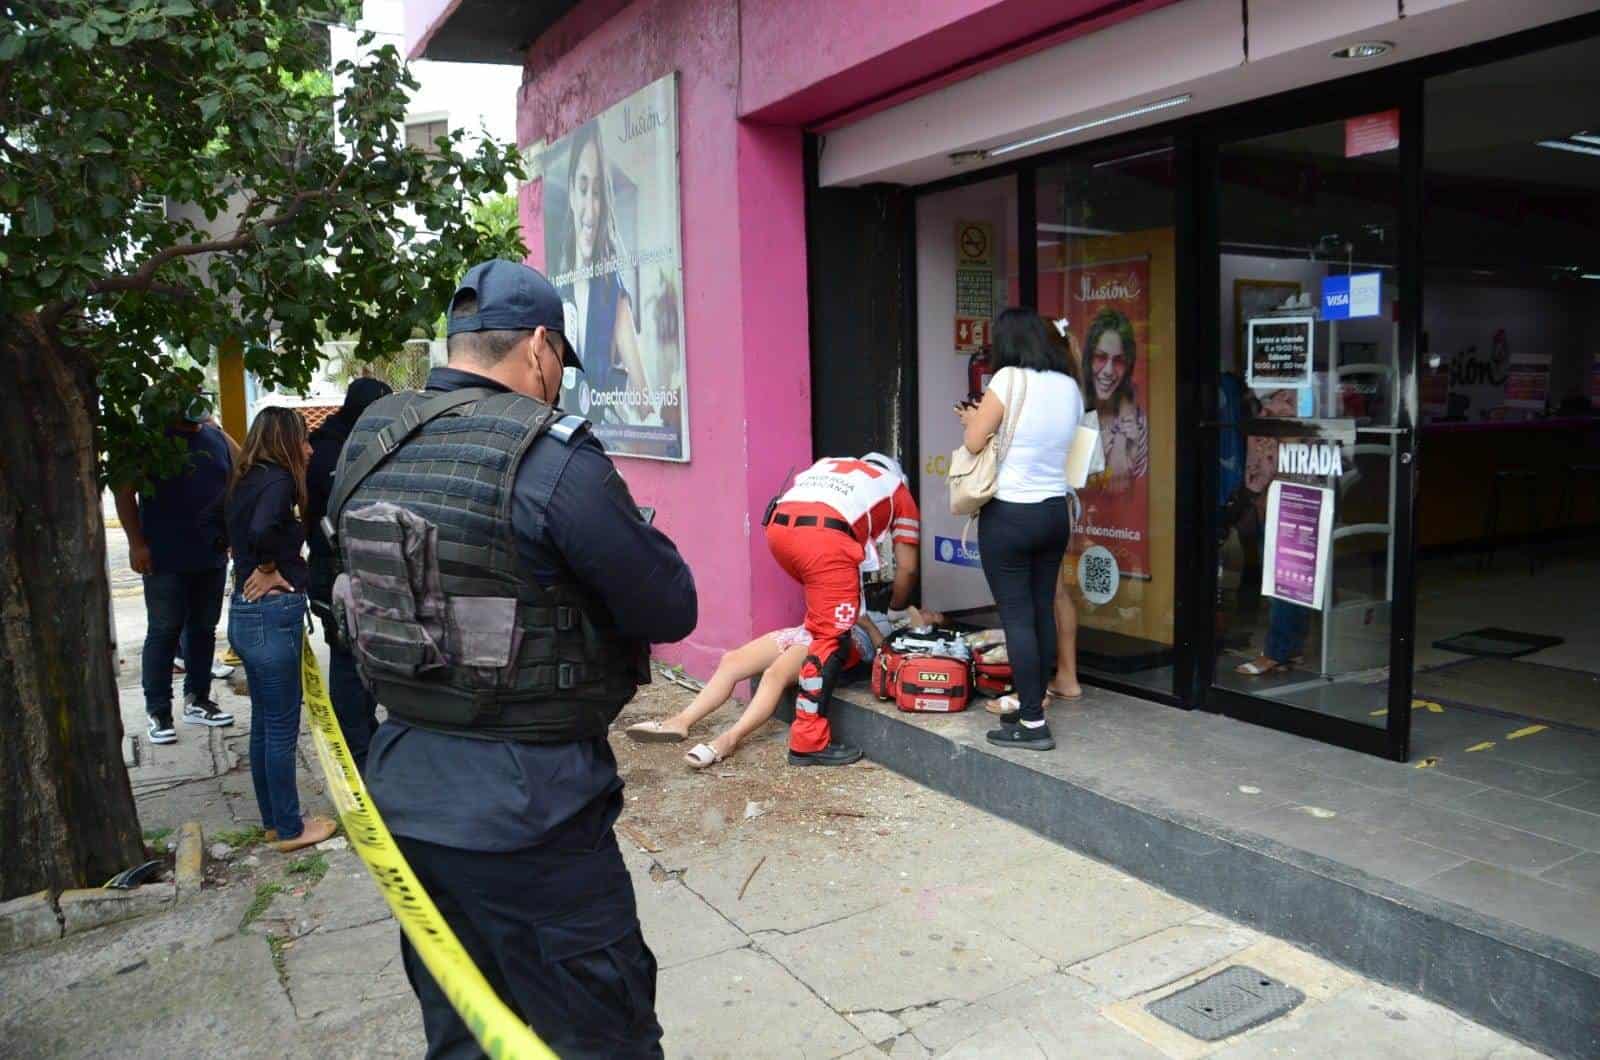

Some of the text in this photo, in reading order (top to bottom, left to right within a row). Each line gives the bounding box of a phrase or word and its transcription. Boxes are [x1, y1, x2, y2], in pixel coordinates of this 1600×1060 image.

[1327, 294, 1348, 307] VISA
[590, 384, 679, 407] Conectando Sueños
[1086, 525, 1141, 541] económica
[920, 673, 947, 681] SVA
